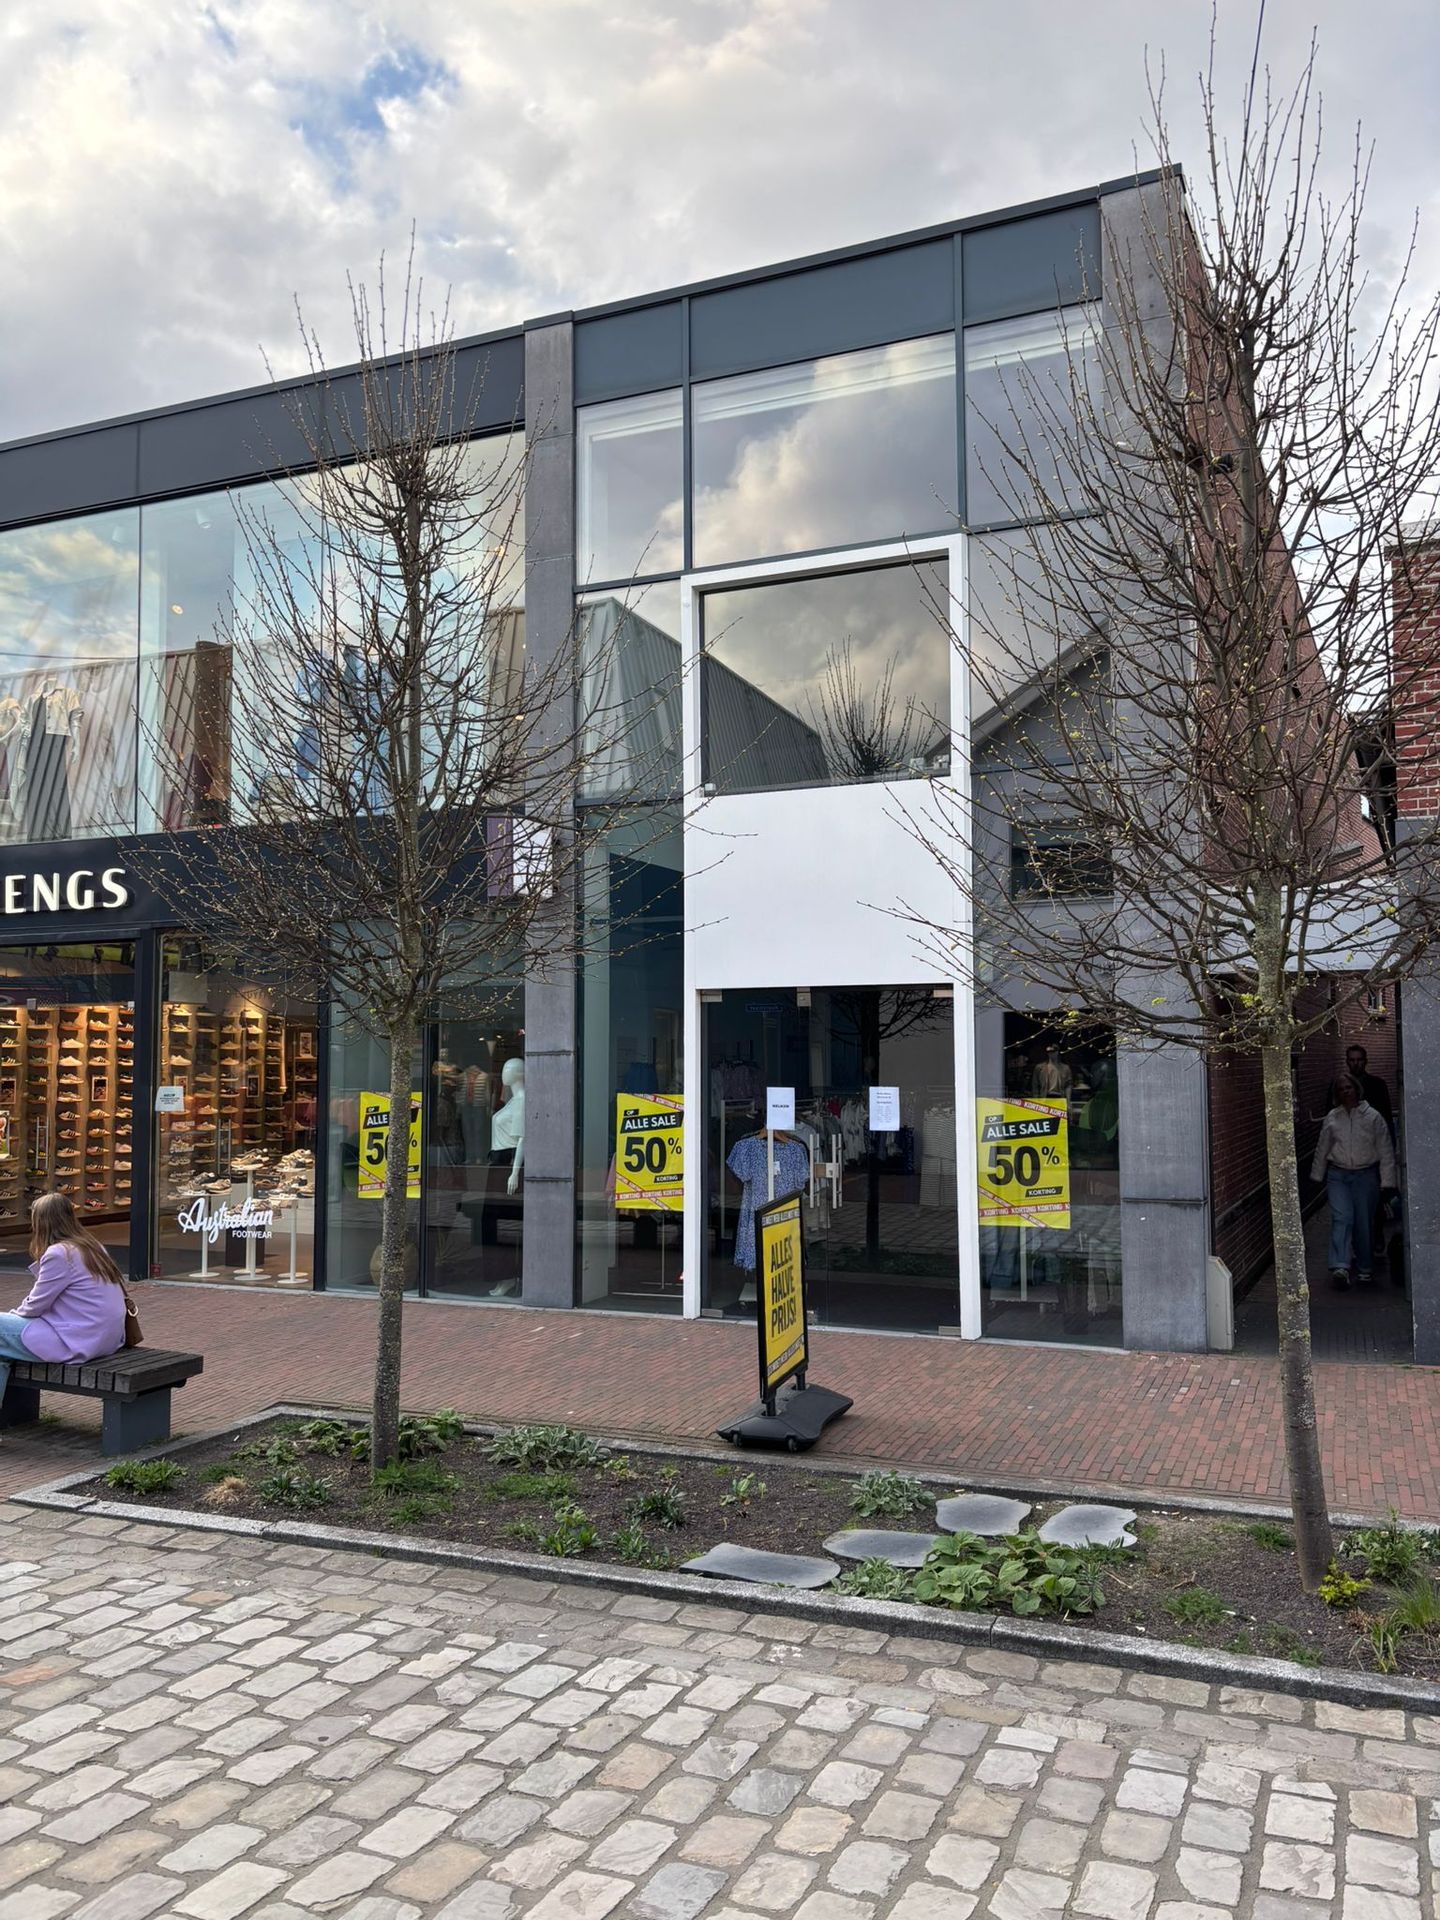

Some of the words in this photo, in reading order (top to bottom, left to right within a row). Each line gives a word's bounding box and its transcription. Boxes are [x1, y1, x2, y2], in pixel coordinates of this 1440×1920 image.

[5, 867, 128, 914] ENGS
[366, 1114, 388, 1126] ALLE
[624, 1118, 649, 1130] ALLE
[651, 1115, 676, 1127] SALE
[987, 1125, 1016, 1138] ALLE
[1019, 1121, 1051, 1134] SALE
[1028, 1188, 1057, 1196] KORTING
[178, 1197, 273, 1243] Australian
[232, 1229, 273, 1240] FOOTWEAR
[771, 1235, 793, 1273] ALLES
[771, 1265, 796, 1306] HALVE
